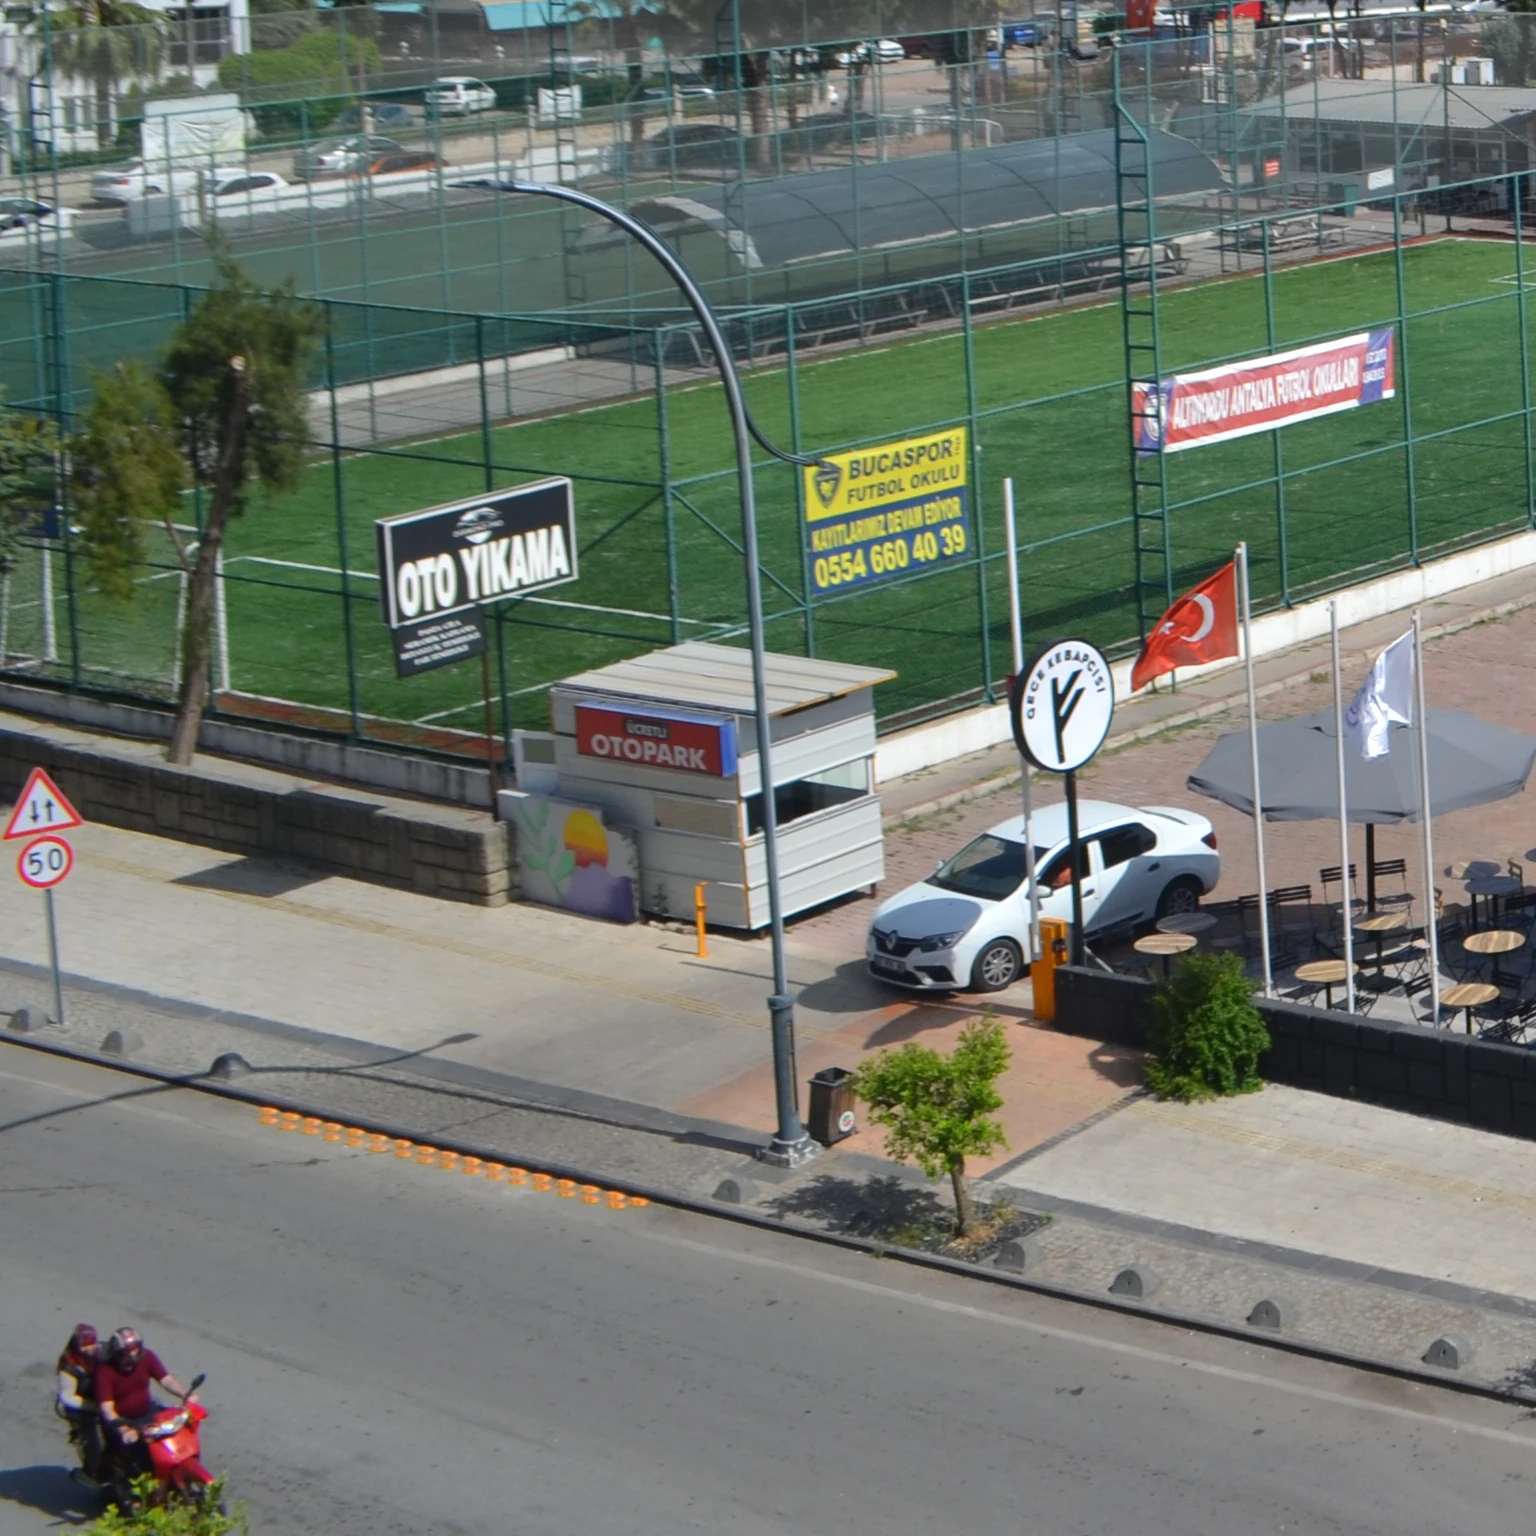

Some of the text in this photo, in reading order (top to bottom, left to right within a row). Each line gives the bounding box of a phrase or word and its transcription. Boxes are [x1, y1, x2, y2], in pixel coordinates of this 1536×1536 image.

[1230, 377, 1277, 418] ANTALYA
[1276, 369, 1312, 405] FUTBOL
[1313, 357, 1359, 397] OKULLARI
[848, 438, 953, 481] BUCASPOR
[847, 464, 960, 504] FUTBOL OKULU
[811, 515, 886, 553] KAYITLARIMIZ
[887, 505, 924, 534] DEVAM
[397, 524, 571, 617] OTO YIKAMA
[814, 524, 966, 588] 0554 660 40 39
[590, 734, 707, 770] OTOPARK
[28, 848, 63, 876] 50
